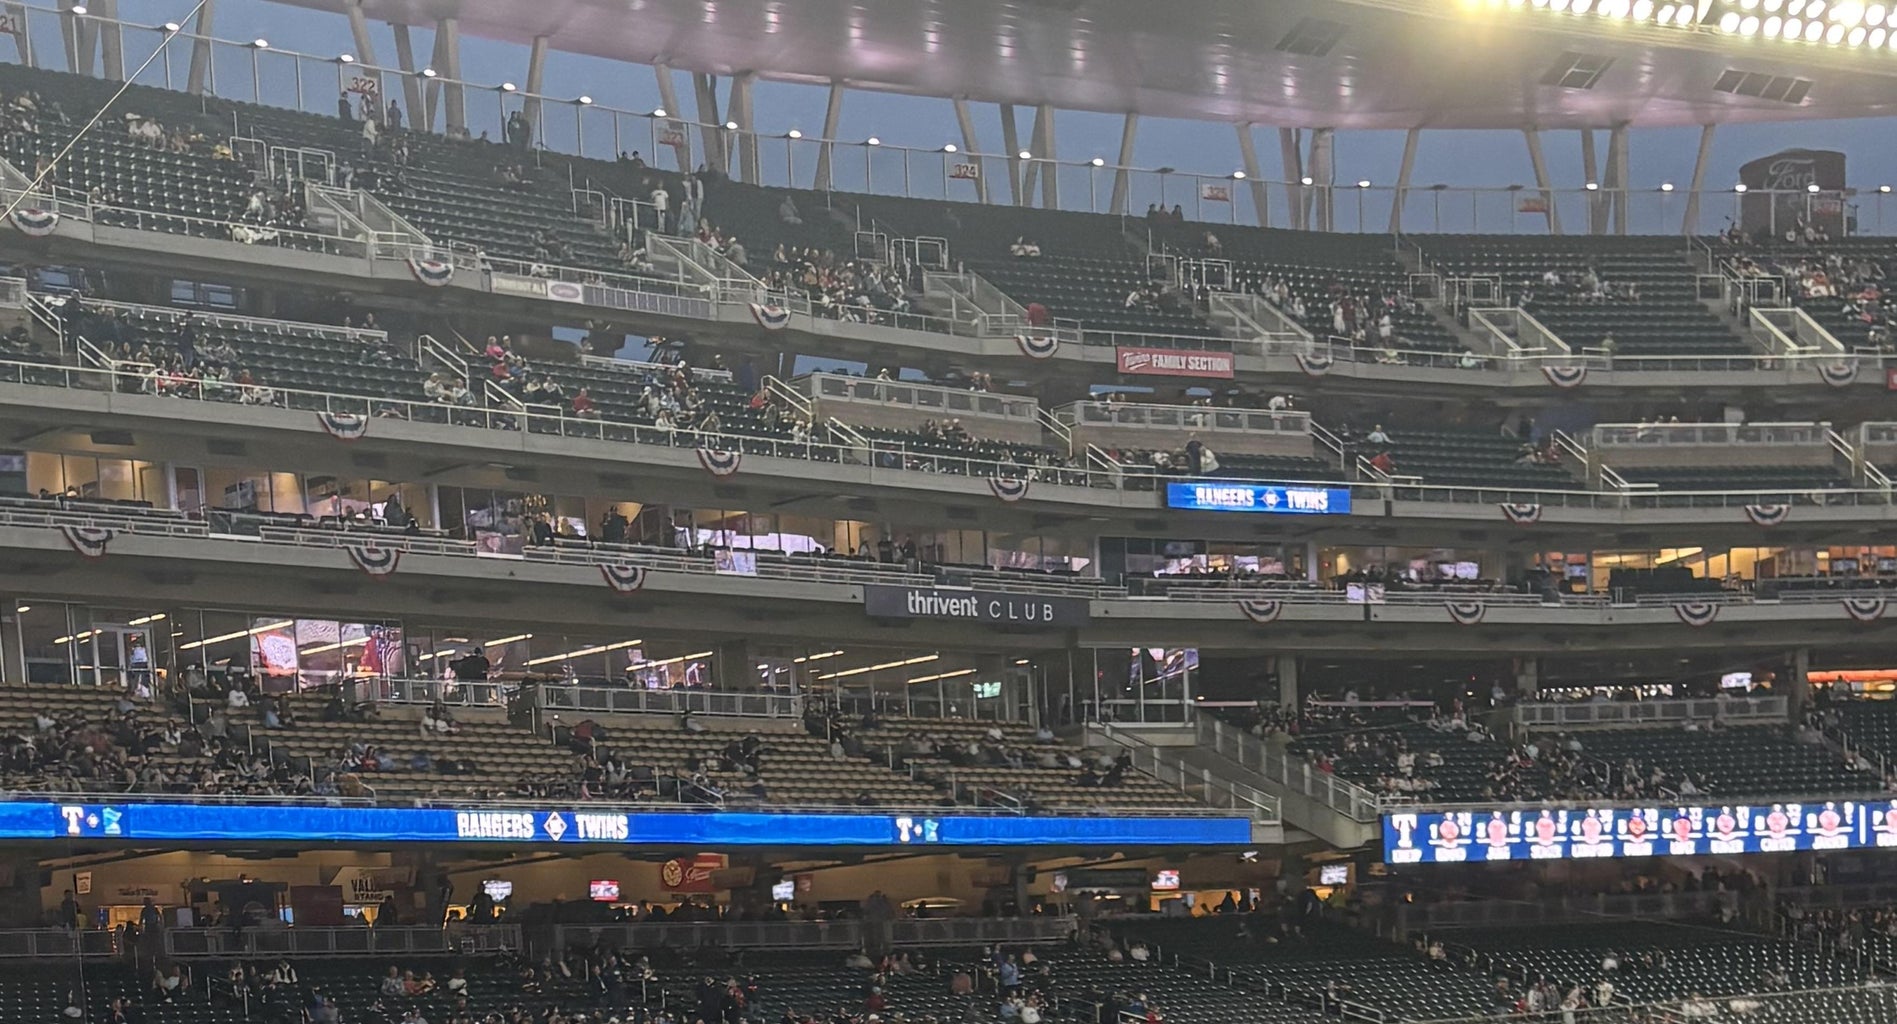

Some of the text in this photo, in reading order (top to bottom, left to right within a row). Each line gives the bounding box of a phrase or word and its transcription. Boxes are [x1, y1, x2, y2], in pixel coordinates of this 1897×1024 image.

[352, 76, 376, 92] 322
[1763, 159, 1816, 190] Ford
[1152, 353, 1186, 370] FAMILY
[1188, 356, 1231, 372] SECTION
[1196, 487, 1328, 511] RANGERS TWINS
[907, 590, 1054, 621] thrivent CLUB
[457, 812, 629, 840] RANGERS TWINS
